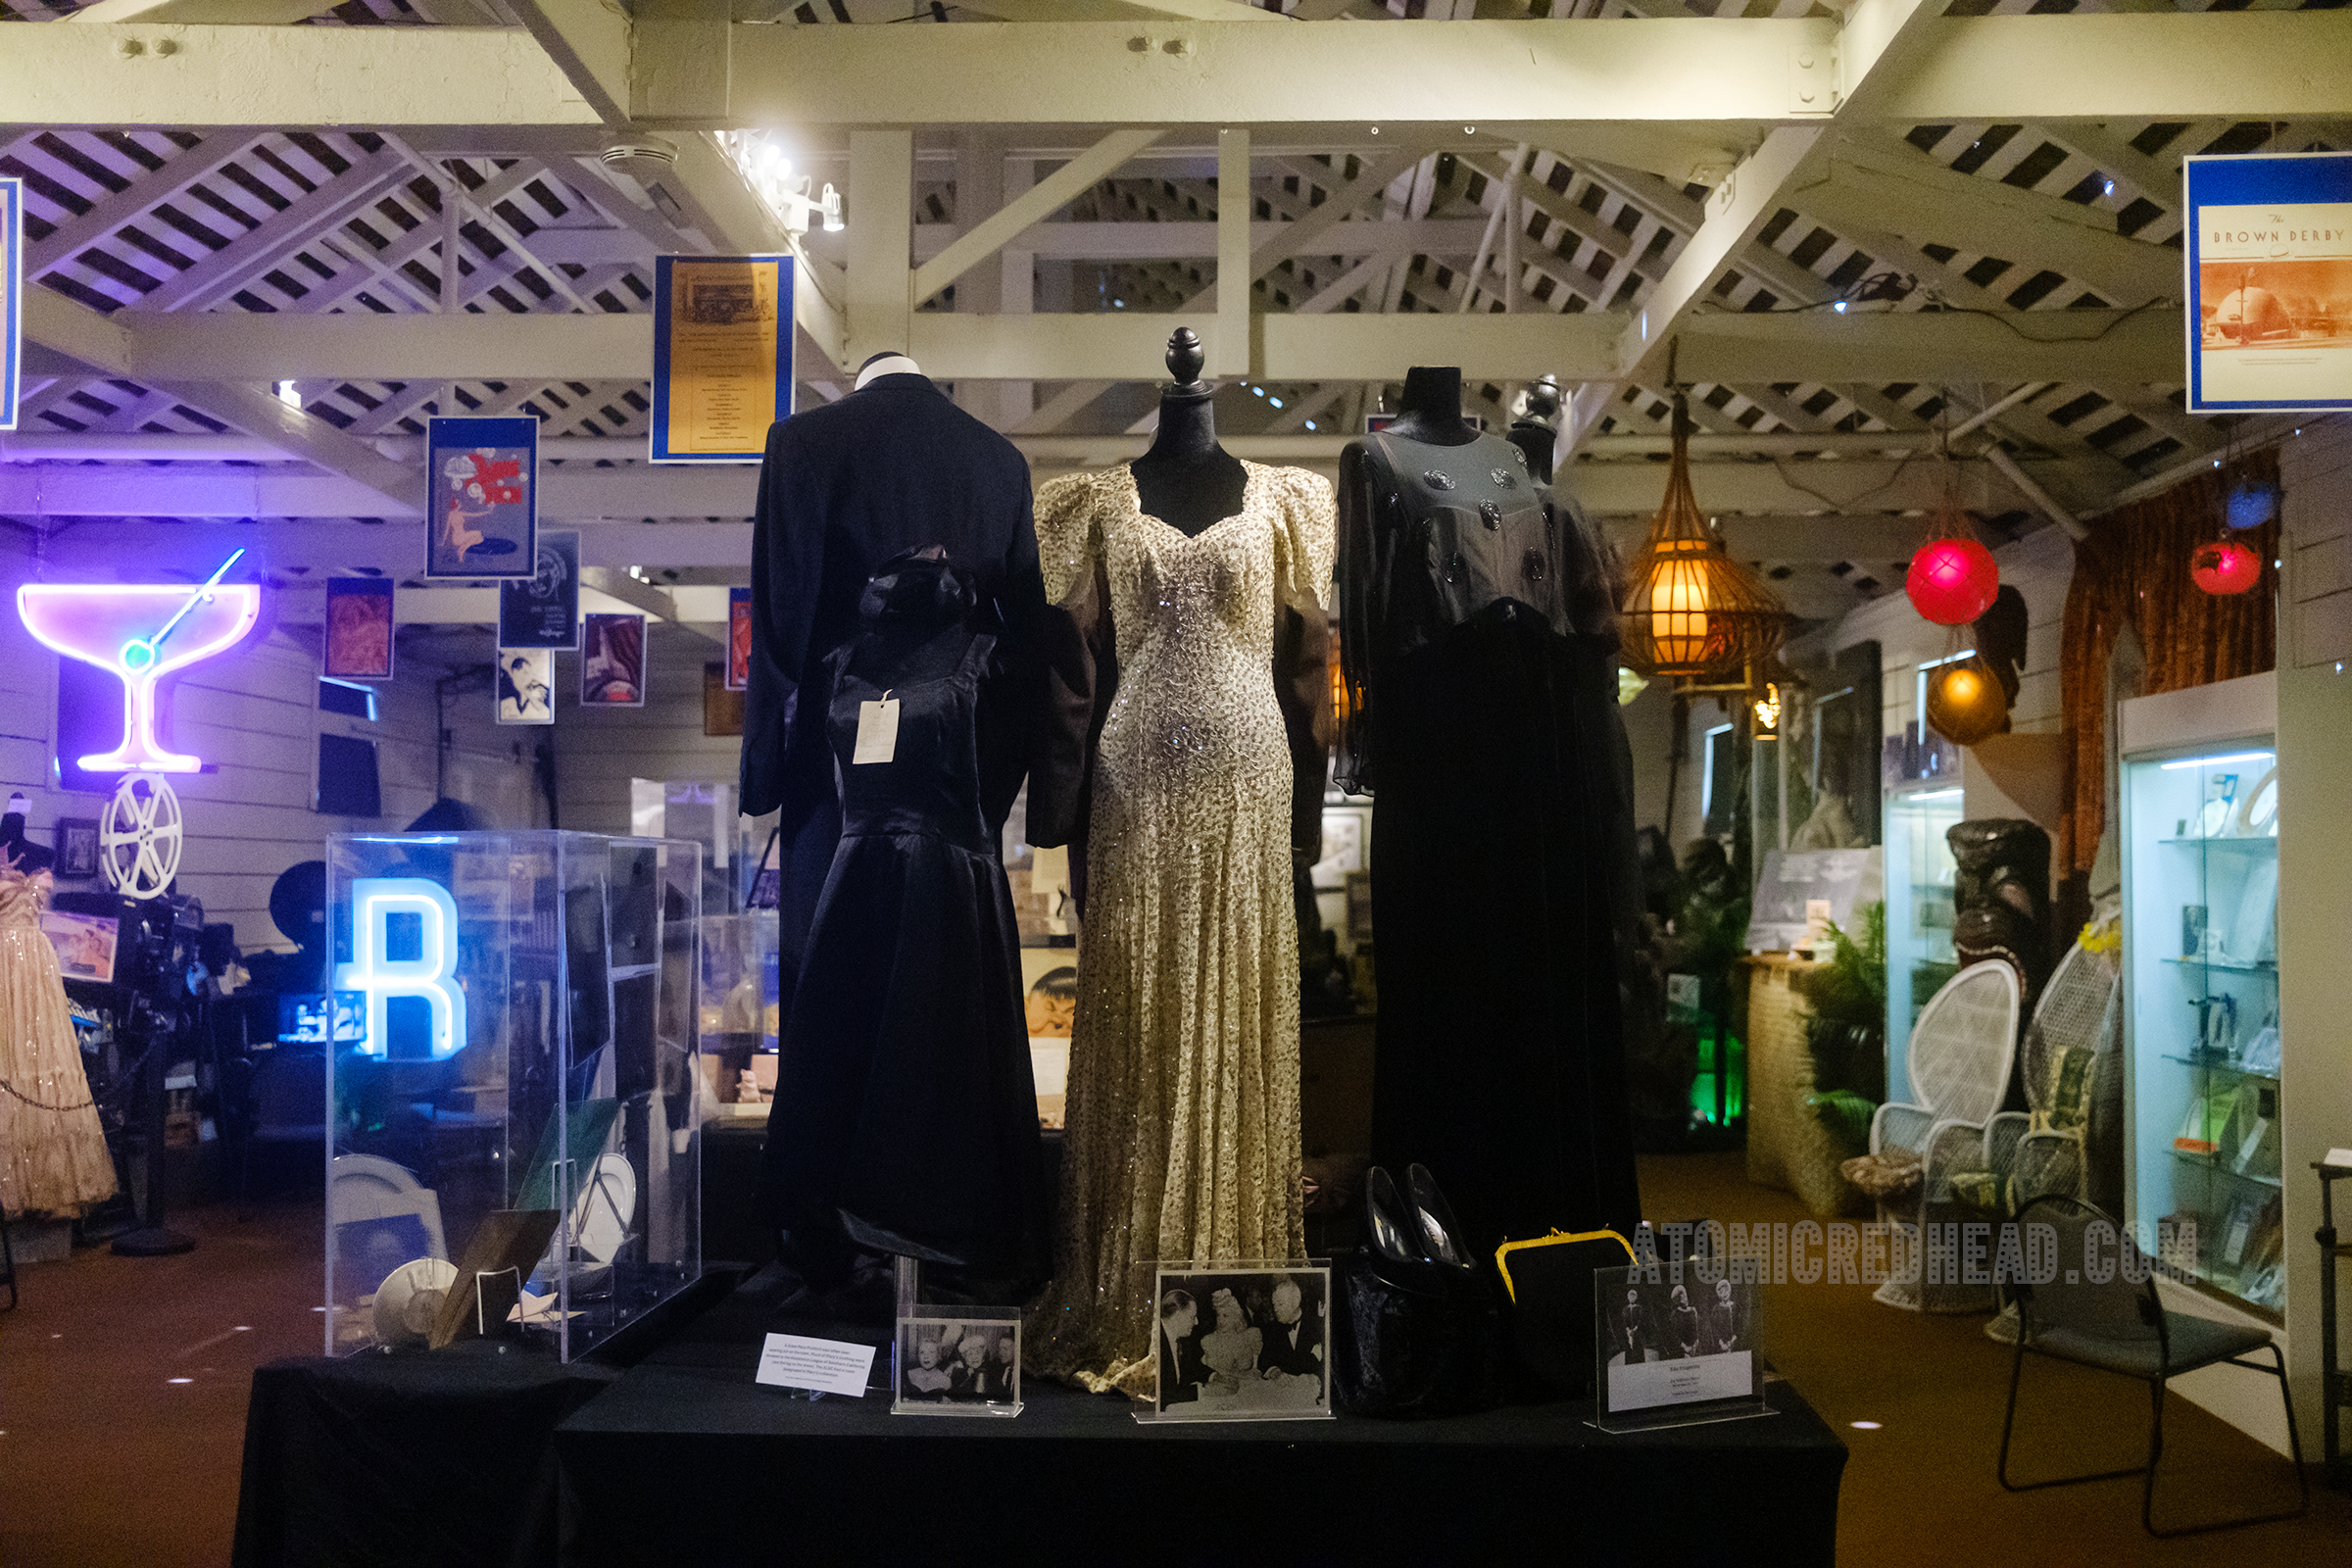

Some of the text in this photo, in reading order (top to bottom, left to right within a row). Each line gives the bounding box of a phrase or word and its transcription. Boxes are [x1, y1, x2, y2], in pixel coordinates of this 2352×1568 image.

[2269, 214, 2284, 223] The
[2214, 229, 2344, 243] BROWN DERBY
[334, 877, 466, 1061] R
